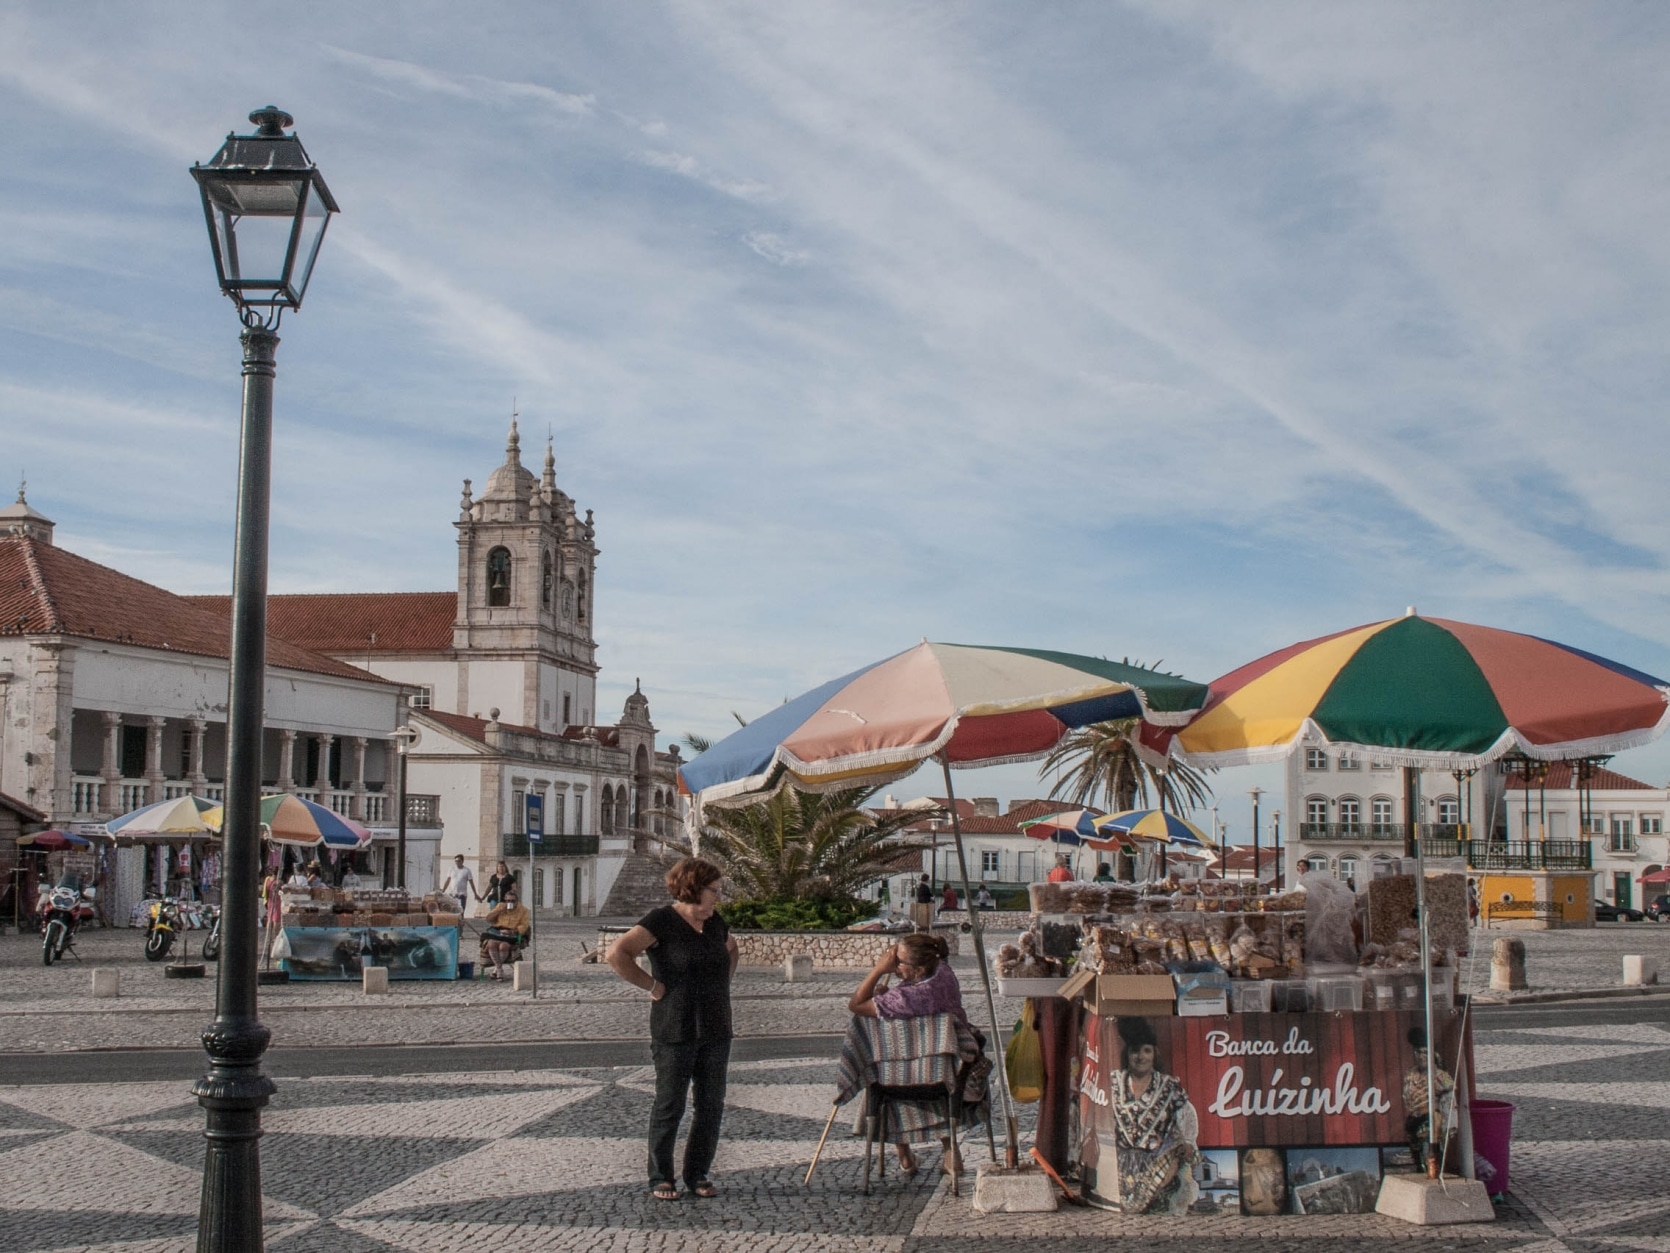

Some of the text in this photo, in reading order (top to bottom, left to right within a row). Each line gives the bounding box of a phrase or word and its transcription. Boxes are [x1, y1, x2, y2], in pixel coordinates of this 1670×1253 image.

[1206, 1026, 1314, 1057] Banca da
[1208, 1062, 1391, 1118] Luízinha
